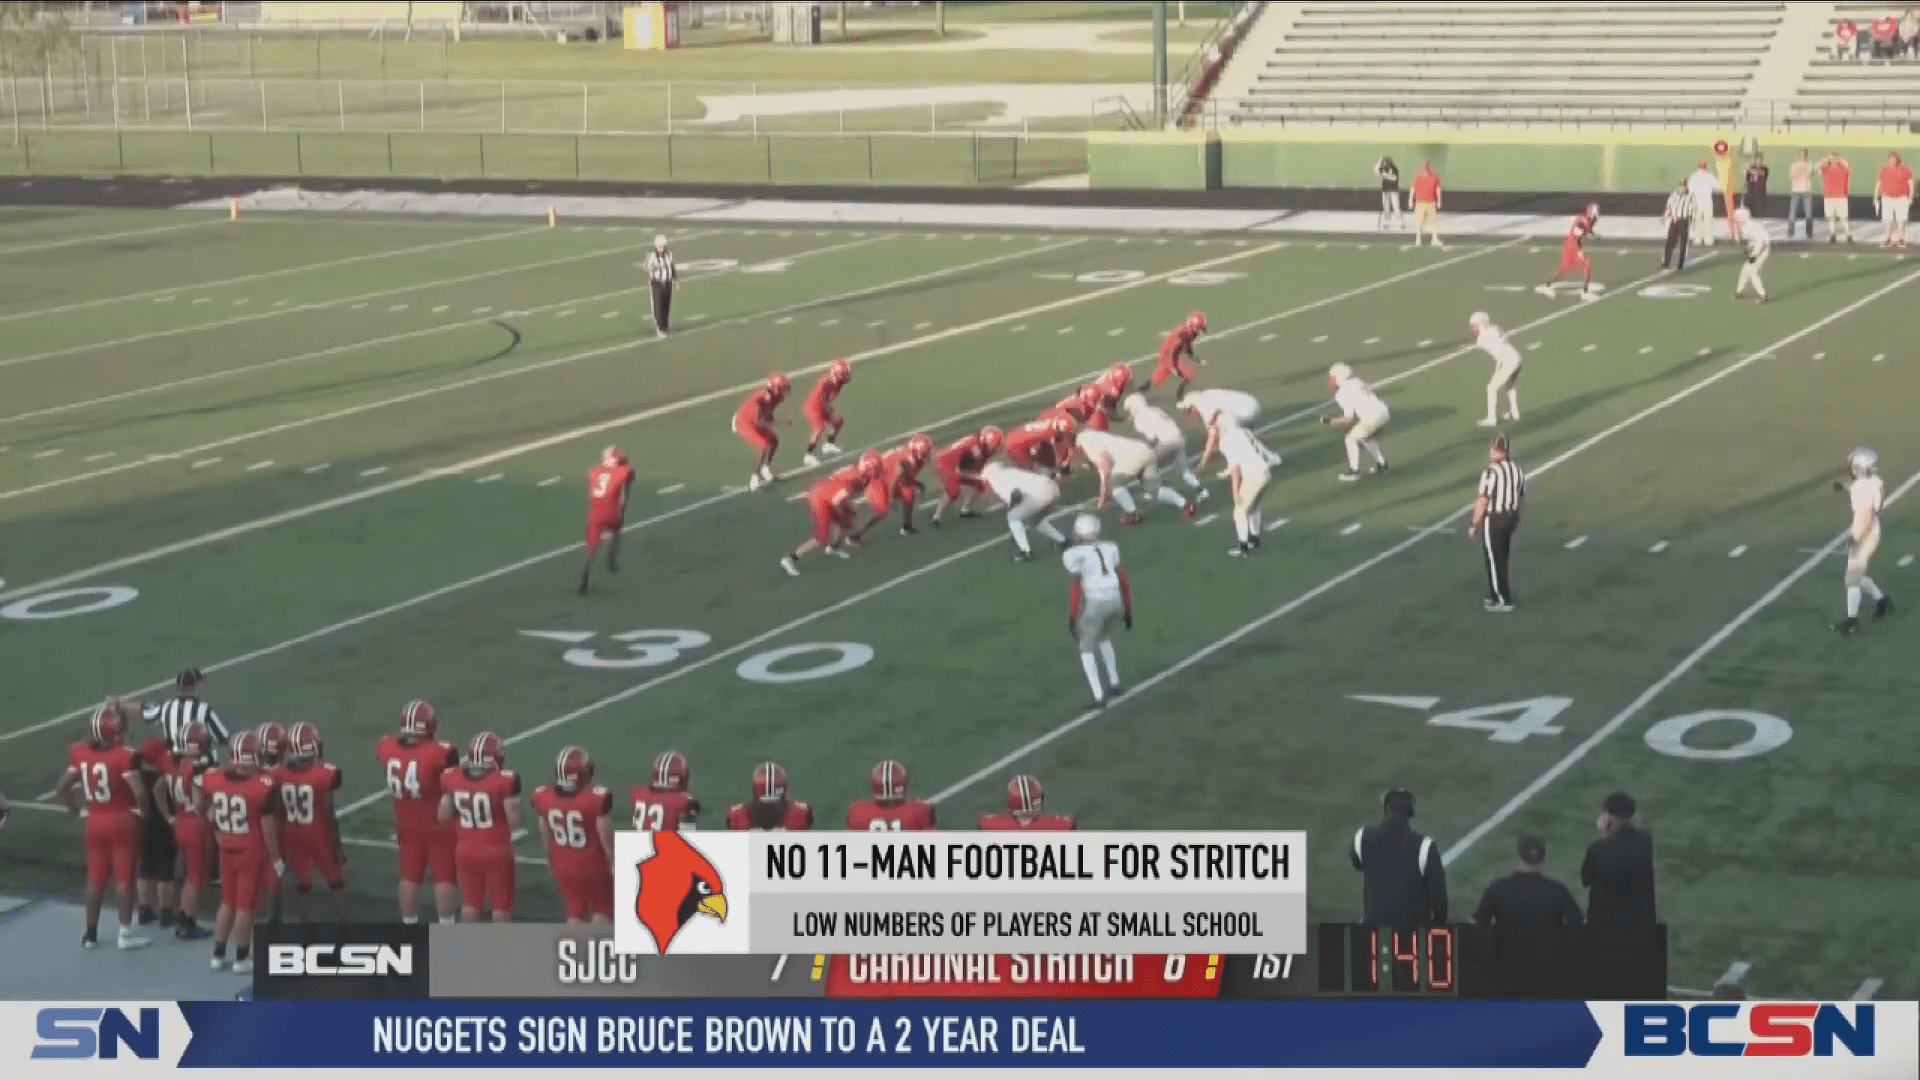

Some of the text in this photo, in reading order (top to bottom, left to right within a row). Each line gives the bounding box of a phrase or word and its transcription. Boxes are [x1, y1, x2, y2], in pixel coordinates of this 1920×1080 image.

[1096, 546, 1109, 575] 1
[80, 761, 111, 802] 13
[386, 757, 422, 799] 64
[213, 791, 249, 834] 22
[454, 791, 493, 829] 50
[549, 809, 586, 849] 66
